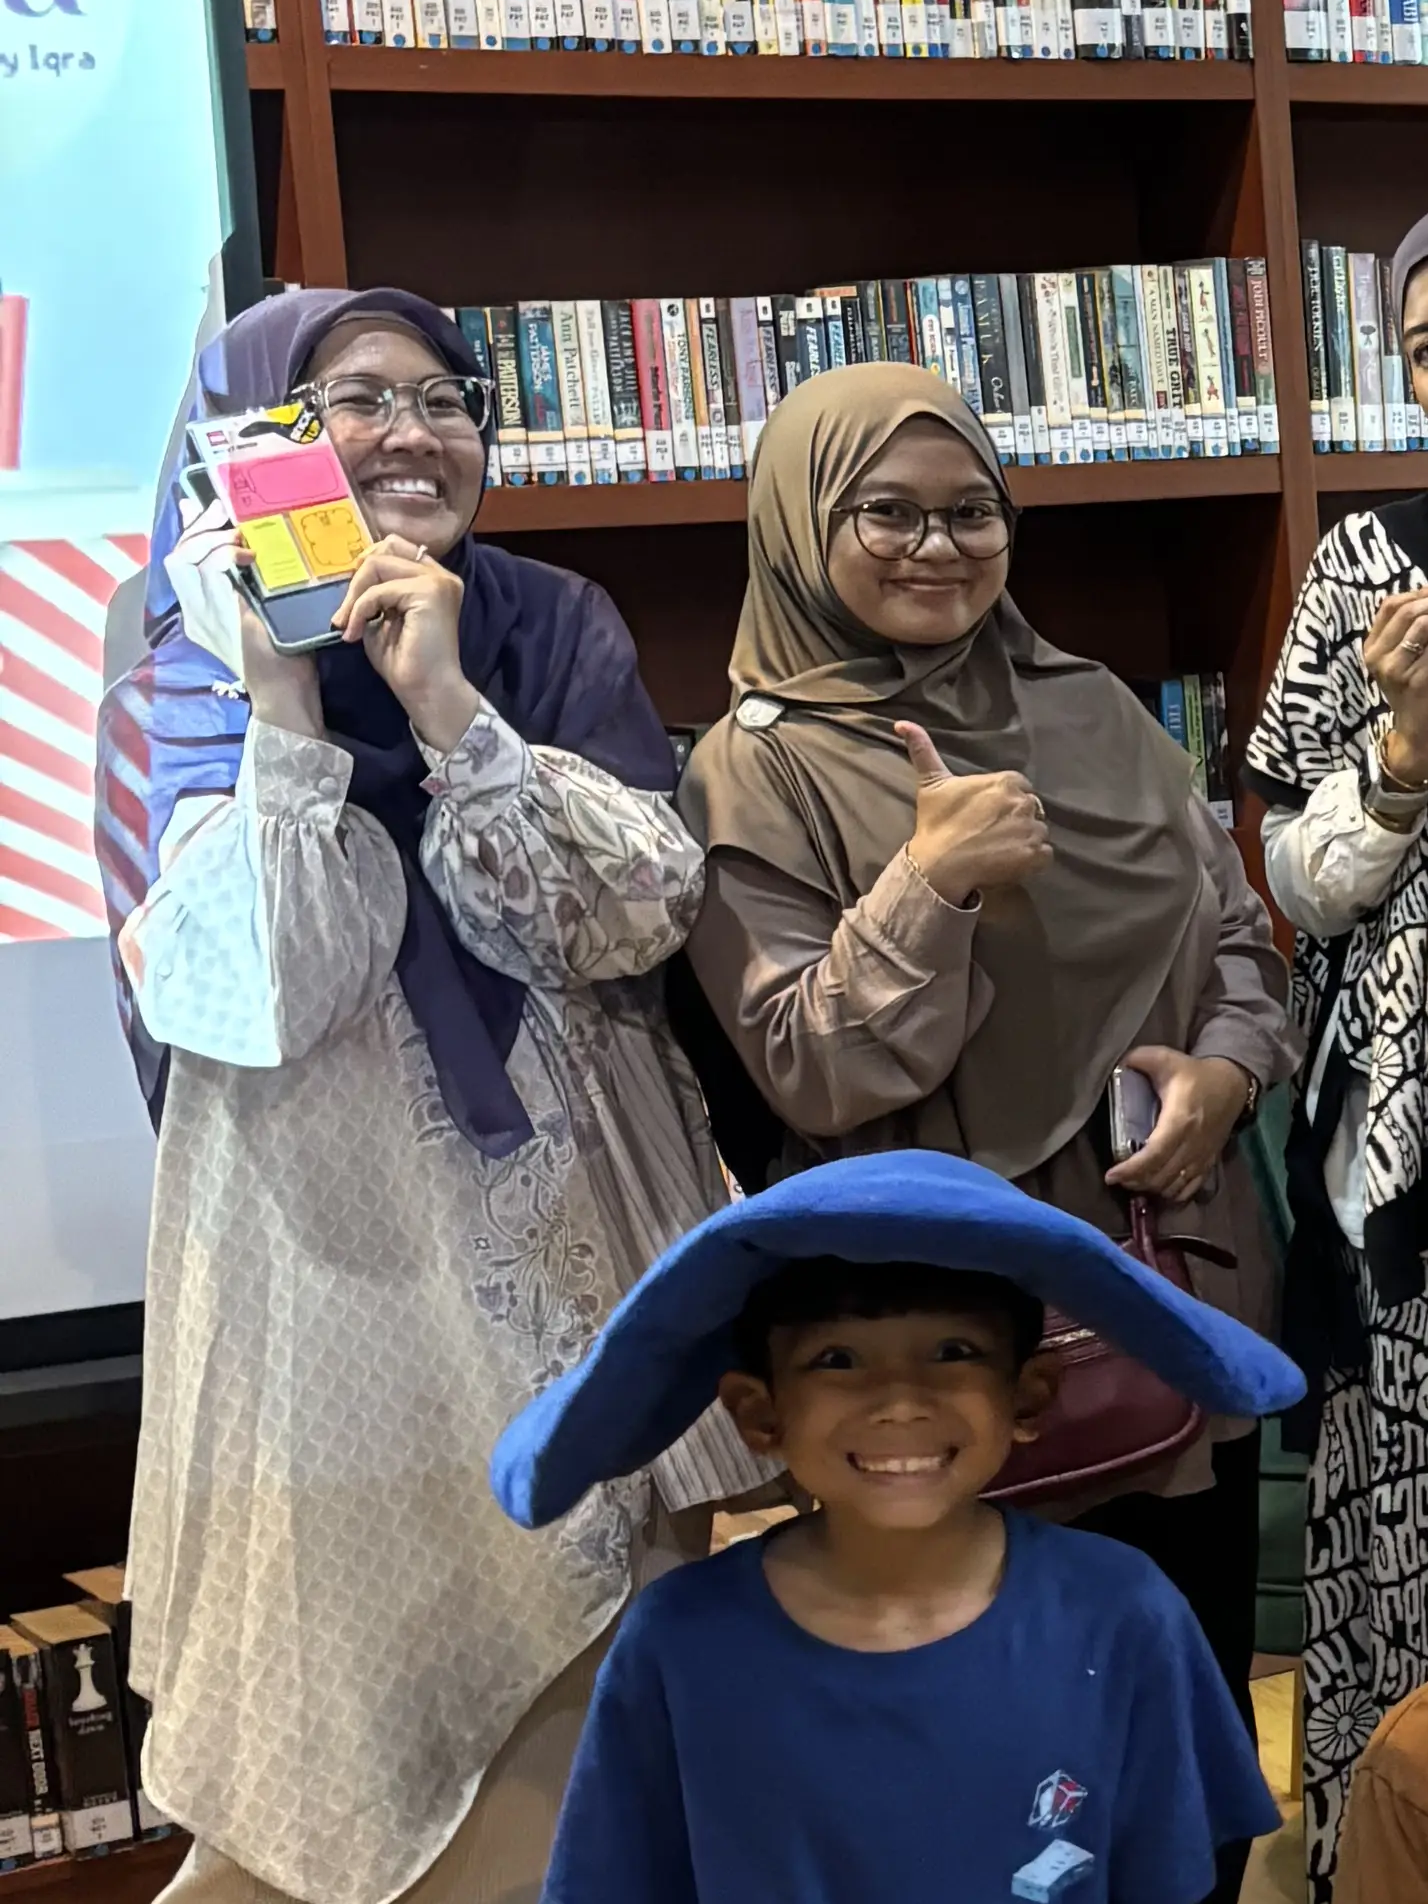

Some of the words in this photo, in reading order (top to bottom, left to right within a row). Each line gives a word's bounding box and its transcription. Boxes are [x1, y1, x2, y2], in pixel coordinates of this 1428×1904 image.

[28, 44, 96, 78] Iqra
[560, 311, 575, 344] Ann
[1165, 327, 1179, 362] TRUE
[705, 325, 720, 389] FEARLESS
[805, 326, 822, 376] FEARLES
[497, 359, 518, 426] PATTERSON
[564, 346, 581, 409] Patchett
[1167, 366, 1183, 409] GRIT
[29, 1729, 45, 1760] NEXT
